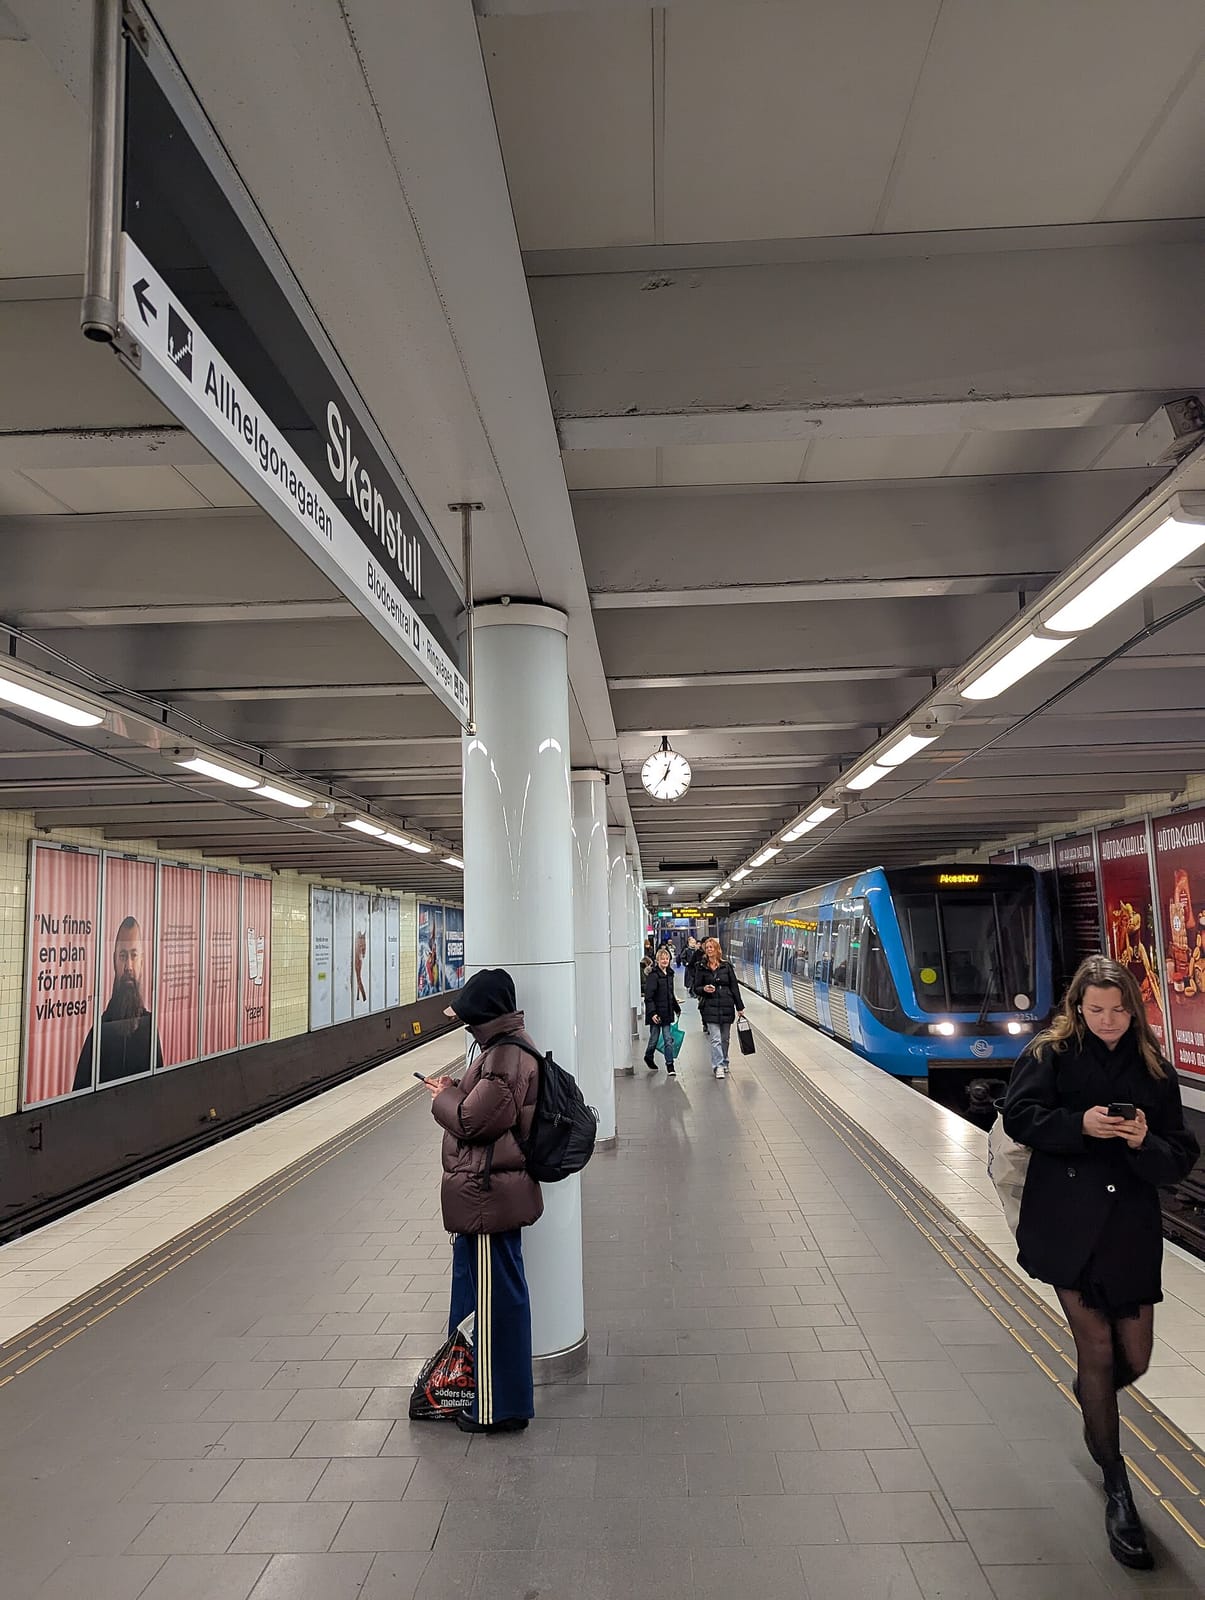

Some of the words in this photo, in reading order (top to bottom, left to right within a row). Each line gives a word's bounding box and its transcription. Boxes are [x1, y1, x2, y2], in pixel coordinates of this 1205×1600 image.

[204, 360, 334, 542] Allhelgonagatan
[326, 400, 422, 598] Skanstull
[62, 914, 92, 935] finns
[39, 946, 56, 963] en
[59, 942, 86, 967] plan
[37, 969, 58, 992] för
[60, 969, 83, 990] min
[245, 1005, 264, 1020] Yazen
